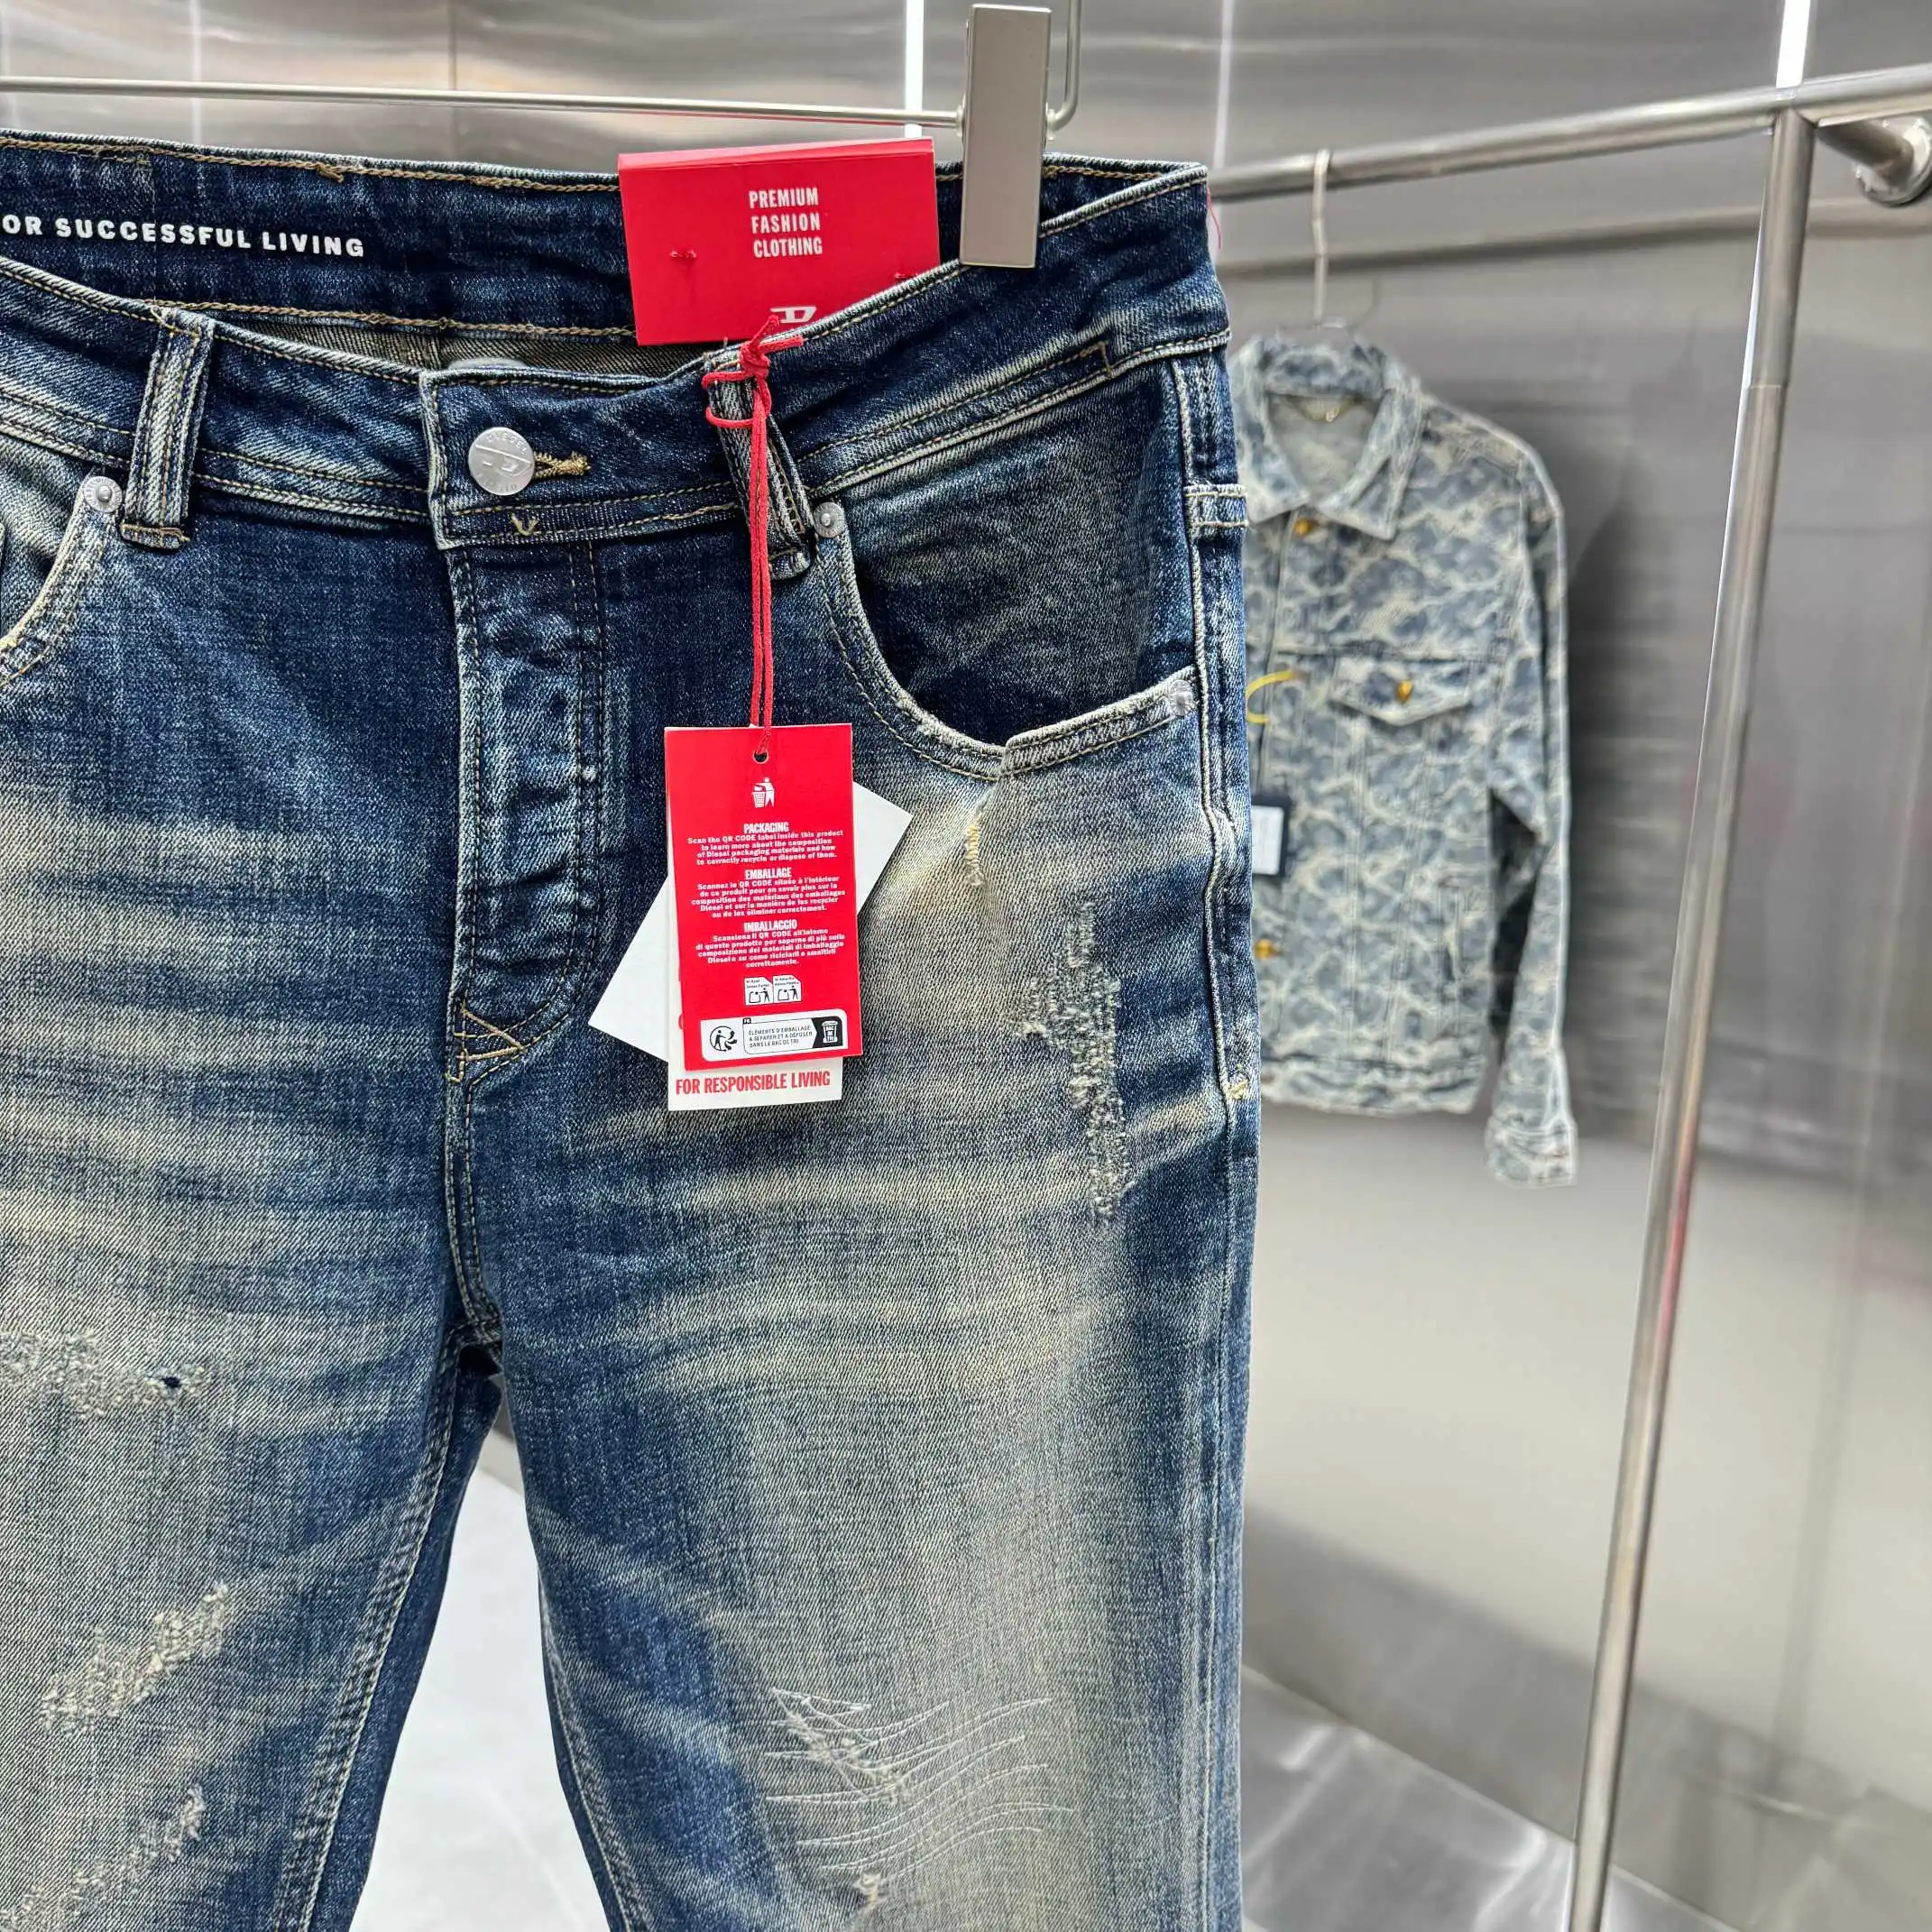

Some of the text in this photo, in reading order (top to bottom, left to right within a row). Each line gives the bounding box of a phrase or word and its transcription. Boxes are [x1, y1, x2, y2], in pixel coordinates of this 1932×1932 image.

[749, 187, 819, 209] PREMIUM
[751, 212, 821, 235] FASHION
[4, 215, 363, 256] OR SUCCESSFUL LIVING
[753, 235, 823, 259] CLOTHING
[743, 822, 789, 834] PACKAGING
[817, 830, 843, 838] product
[731, 849, 770, 857] packaging
[707, 857, 740, 865] correctly
[745, 867, 792, 880] EMBALLAGE
[722, 888, 747, 897] produit
[691, 897, 736, 906] composition
[810, 897, 839, 905] recycler
[743, 919, 797, 933] IMBALLAGGIO
[759, 932, 768, 940] QR
[698, 949, 747, 957] composizione
[762, 944, 794, 952] materiali
[705, 942, 730, 951] questo
[731, 941, 762, 950] prodotto
[676, 1071, 831, 1095] FOR RESPONSIBLE LIVING
